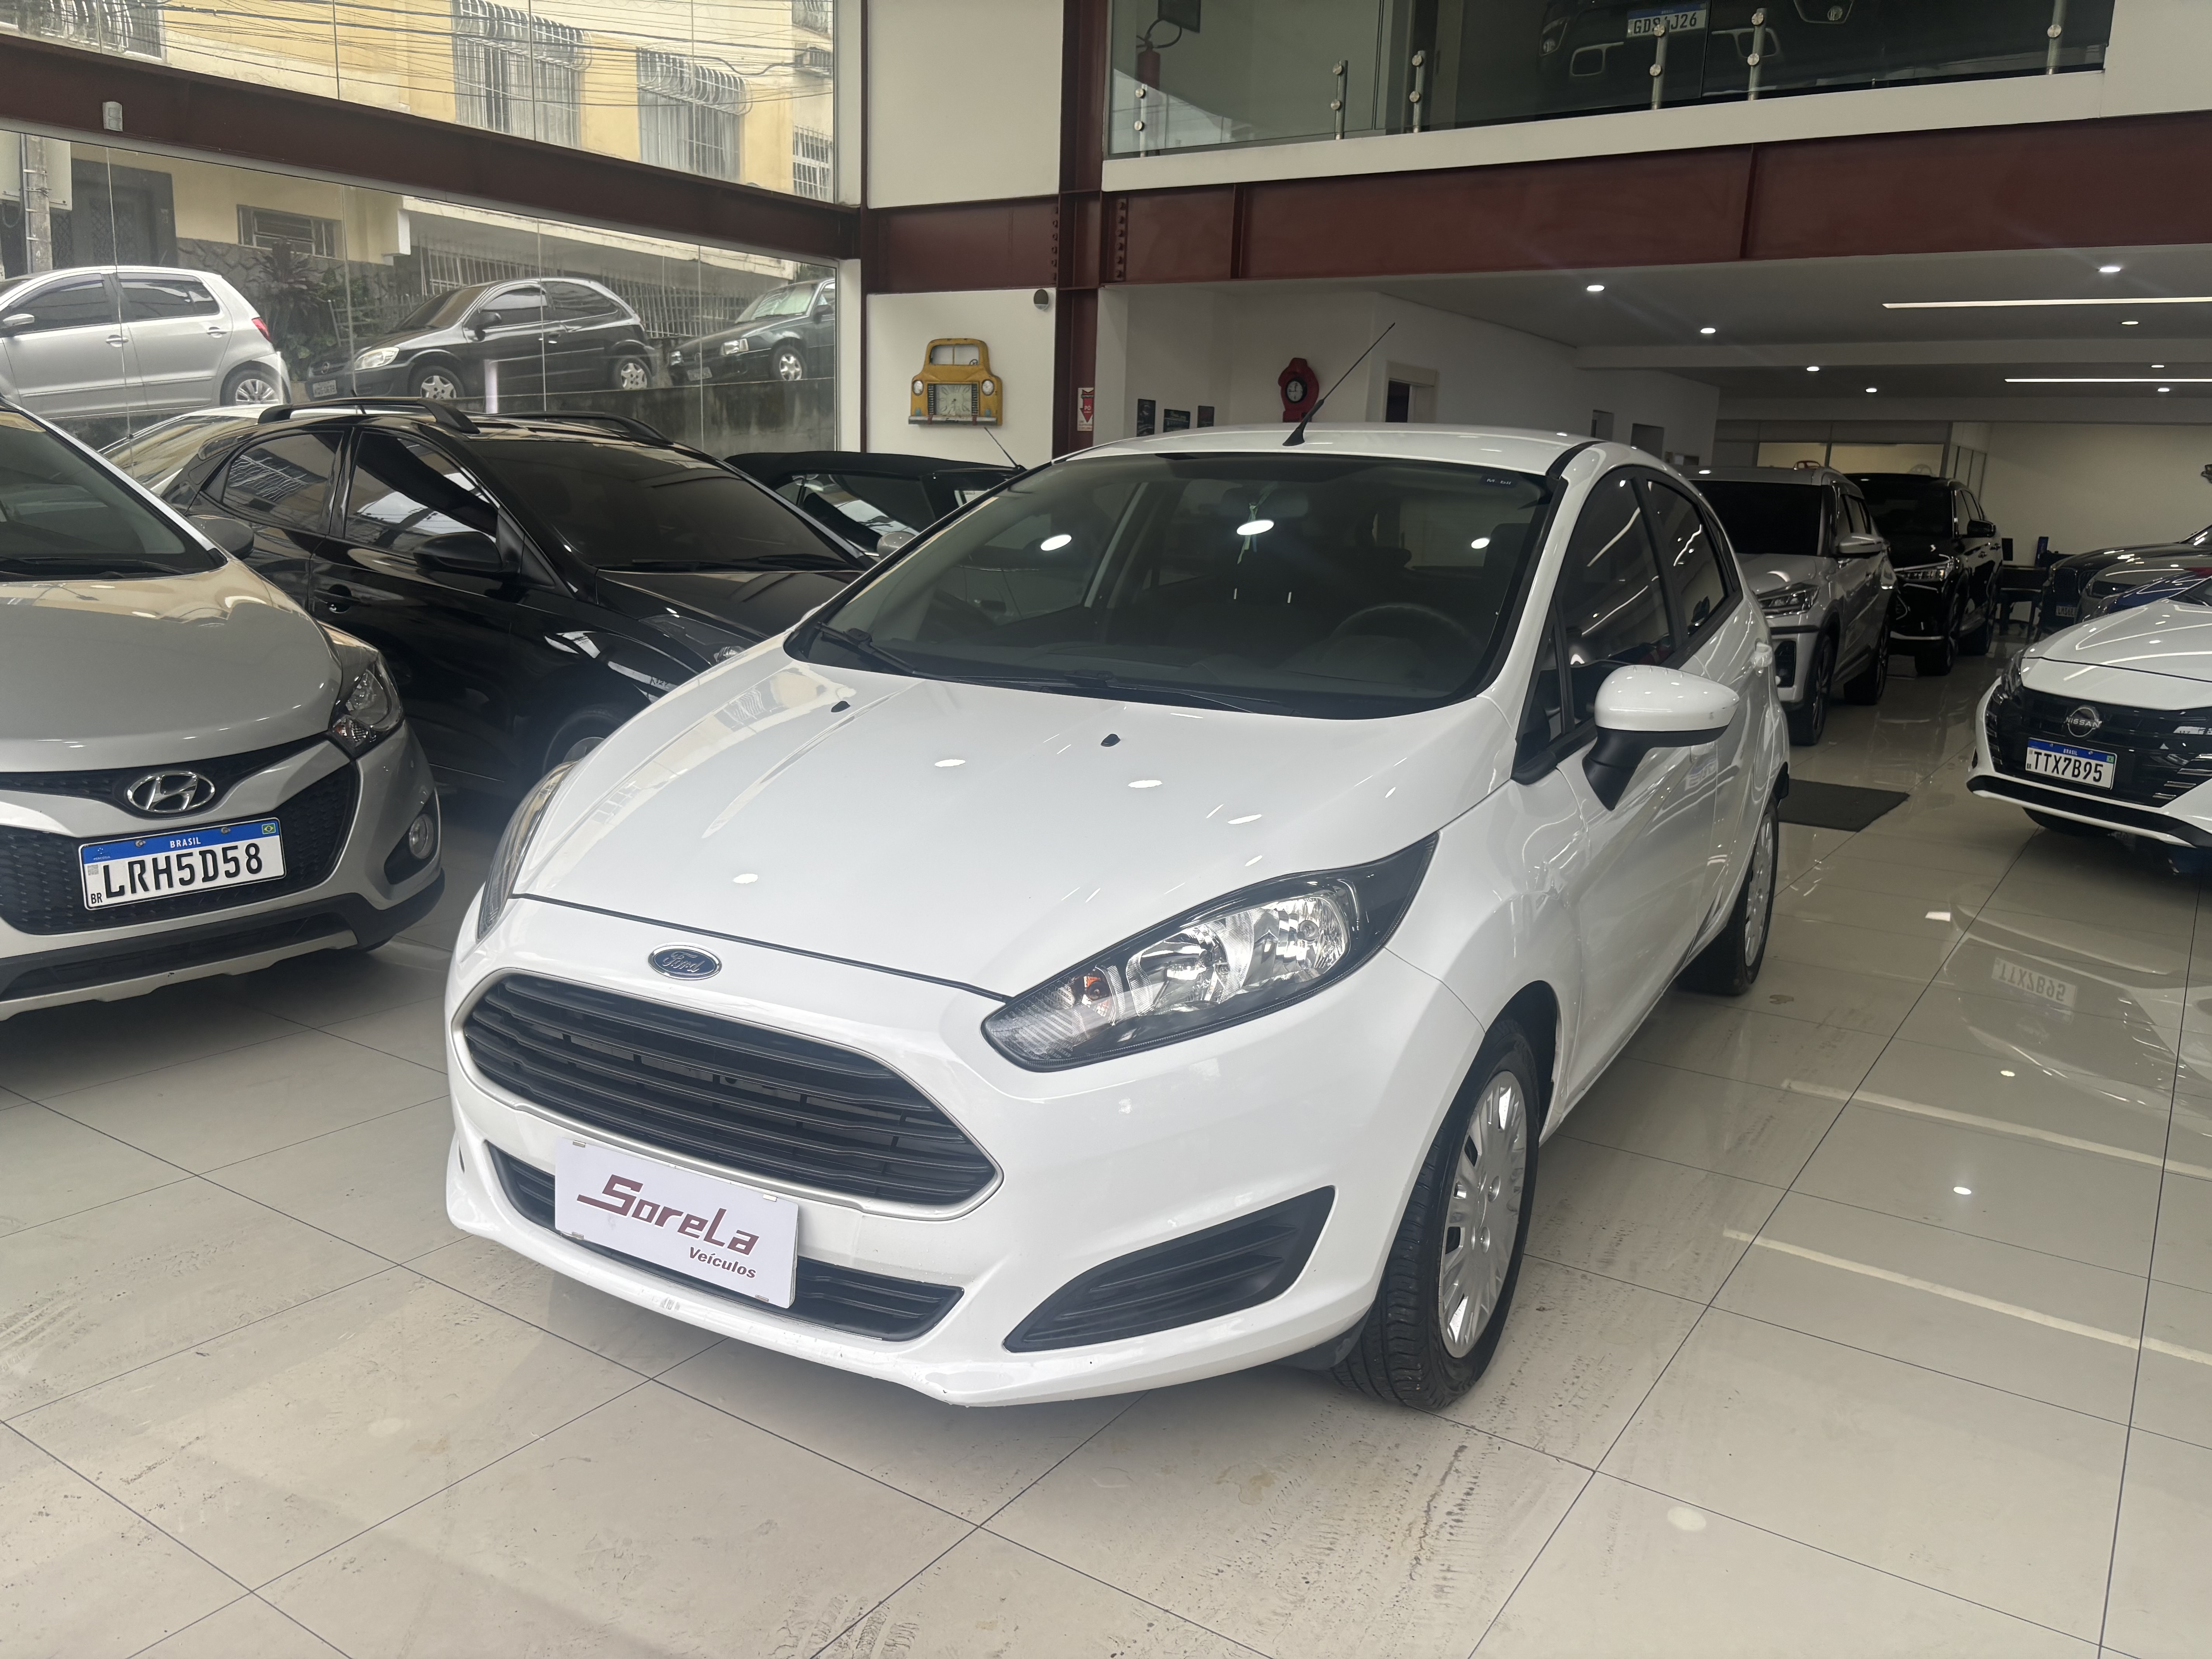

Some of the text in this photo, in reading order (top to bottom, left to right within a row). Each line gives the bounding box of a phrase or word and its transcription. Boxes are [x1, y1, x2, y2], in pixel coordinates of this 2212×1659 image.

[1633, 12, 1697, 34] GDSJ26
[2065, 716, 2102, 728] NISSAN
[2034, 751, 2104, 782] TTX7B95
[170, 836, 201, 848] BRASIL
[103, 843, 263, 899] LRH5D58
[91, 891, 103, 905] BR
[663, 951, 705, 973] Ford
[689, 1246, 757, 1279] Veículos
